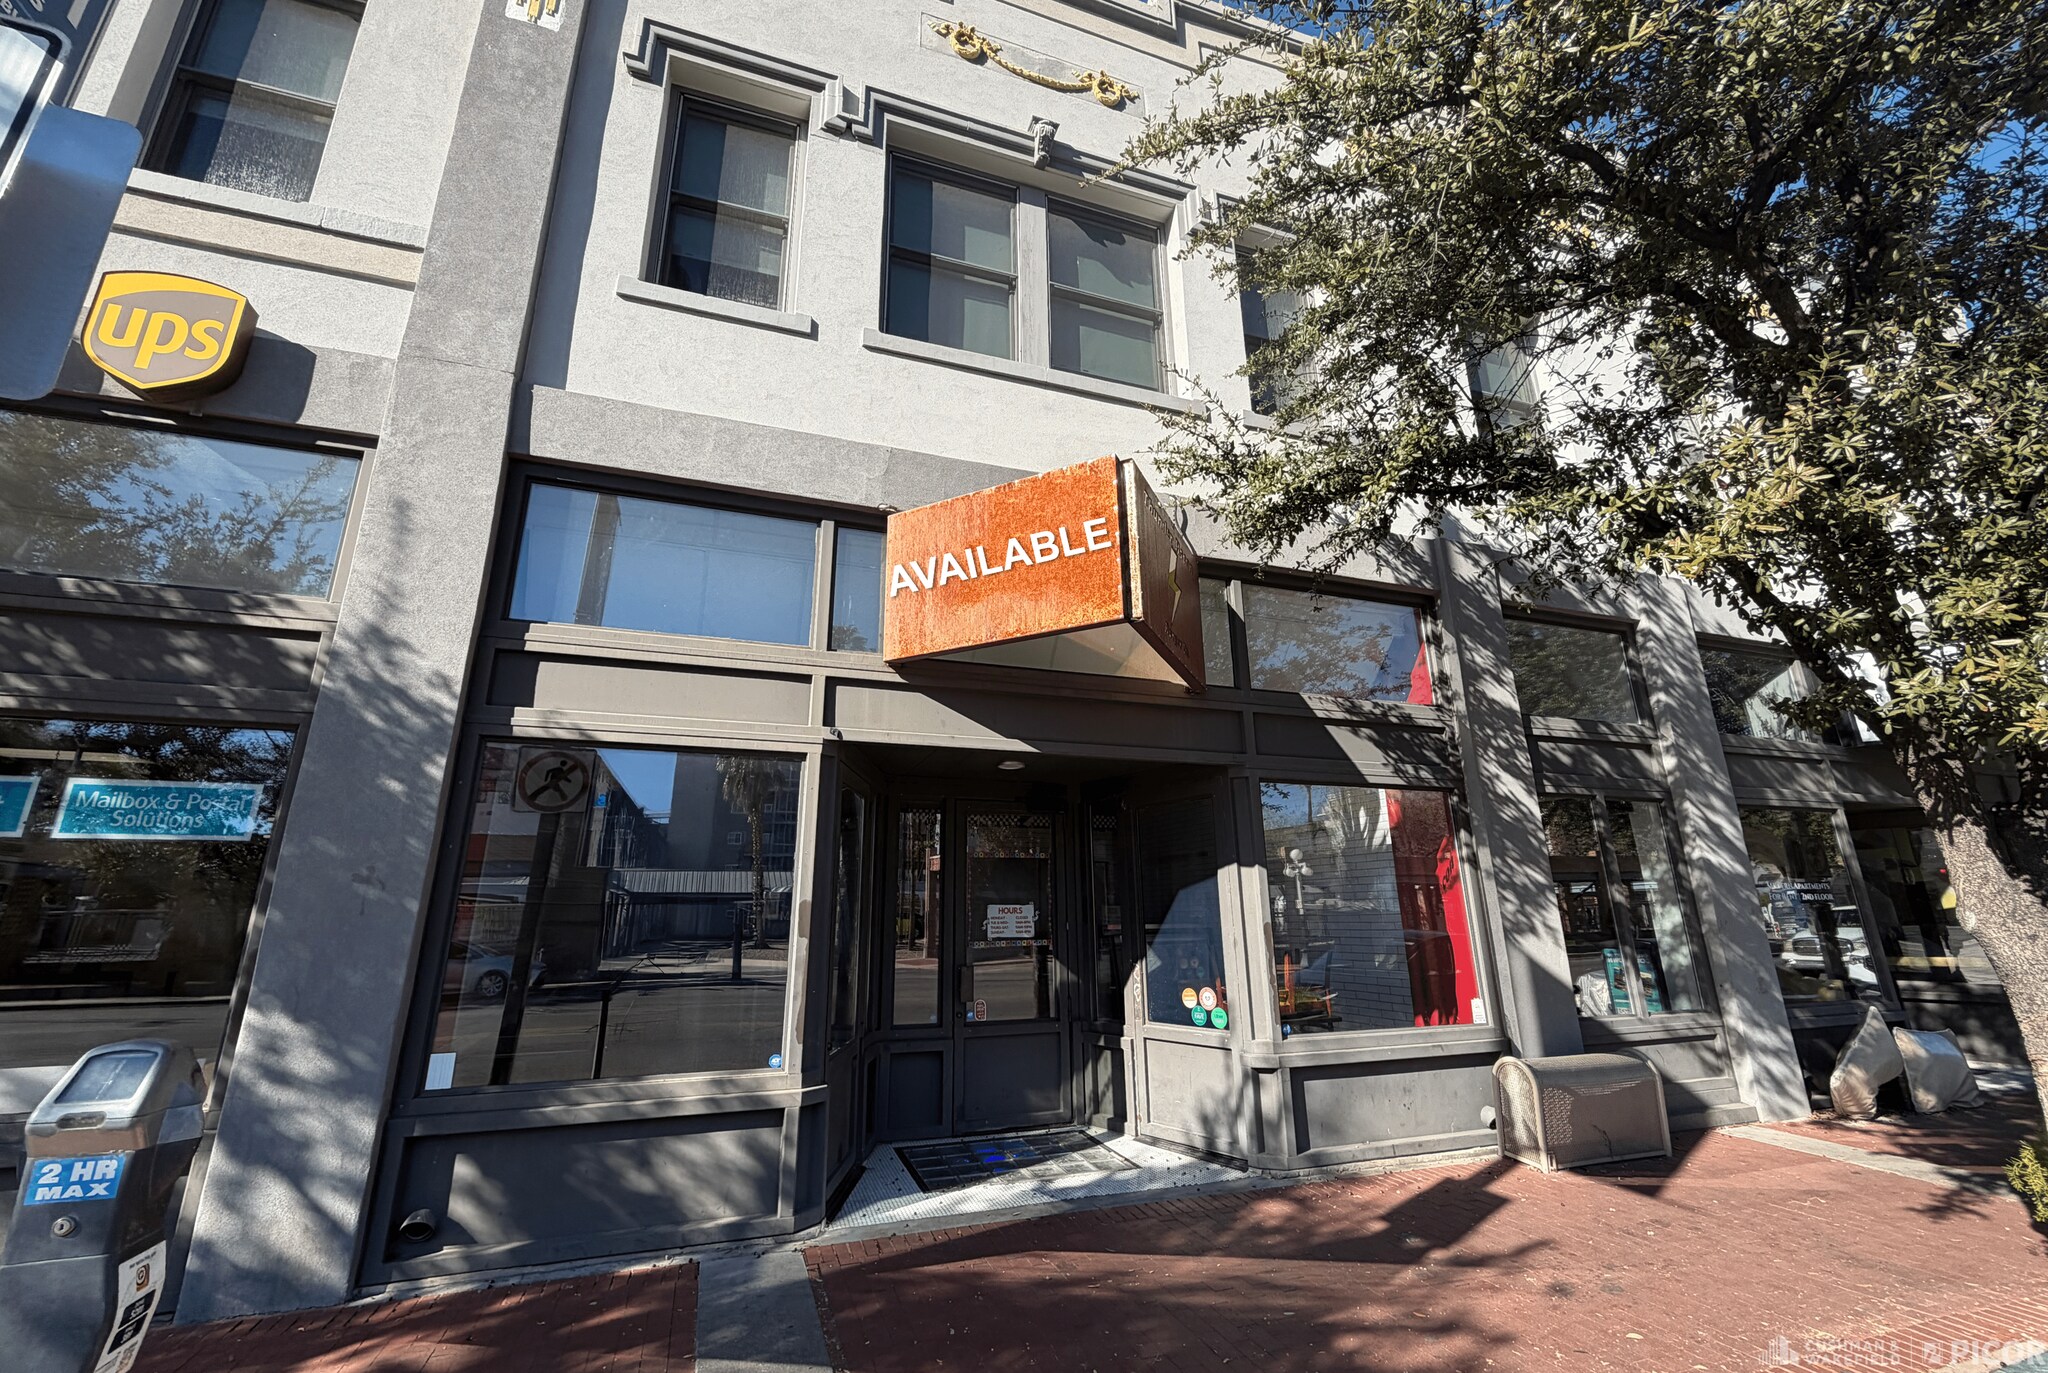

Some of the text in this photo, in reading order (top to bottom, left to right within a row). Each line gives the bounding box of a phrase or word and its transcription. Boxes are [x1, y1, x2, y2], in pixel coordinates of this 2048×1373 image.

[98, 303, 225, 370] ups
[889, 517, 1113, 598] AVAILABLE
[76, 790, 159, 809] Mailbox
[165, 792, 182, 809] &
[110, 810, 204, 828] Solutions
[1794, 881, 1831, 890] APARTMENTS
[1814, 893, 1834, 901] FLOOR
[37, 1159, 119, 1185] 2 HR
[34, 1182, 111, 1200] MAX
